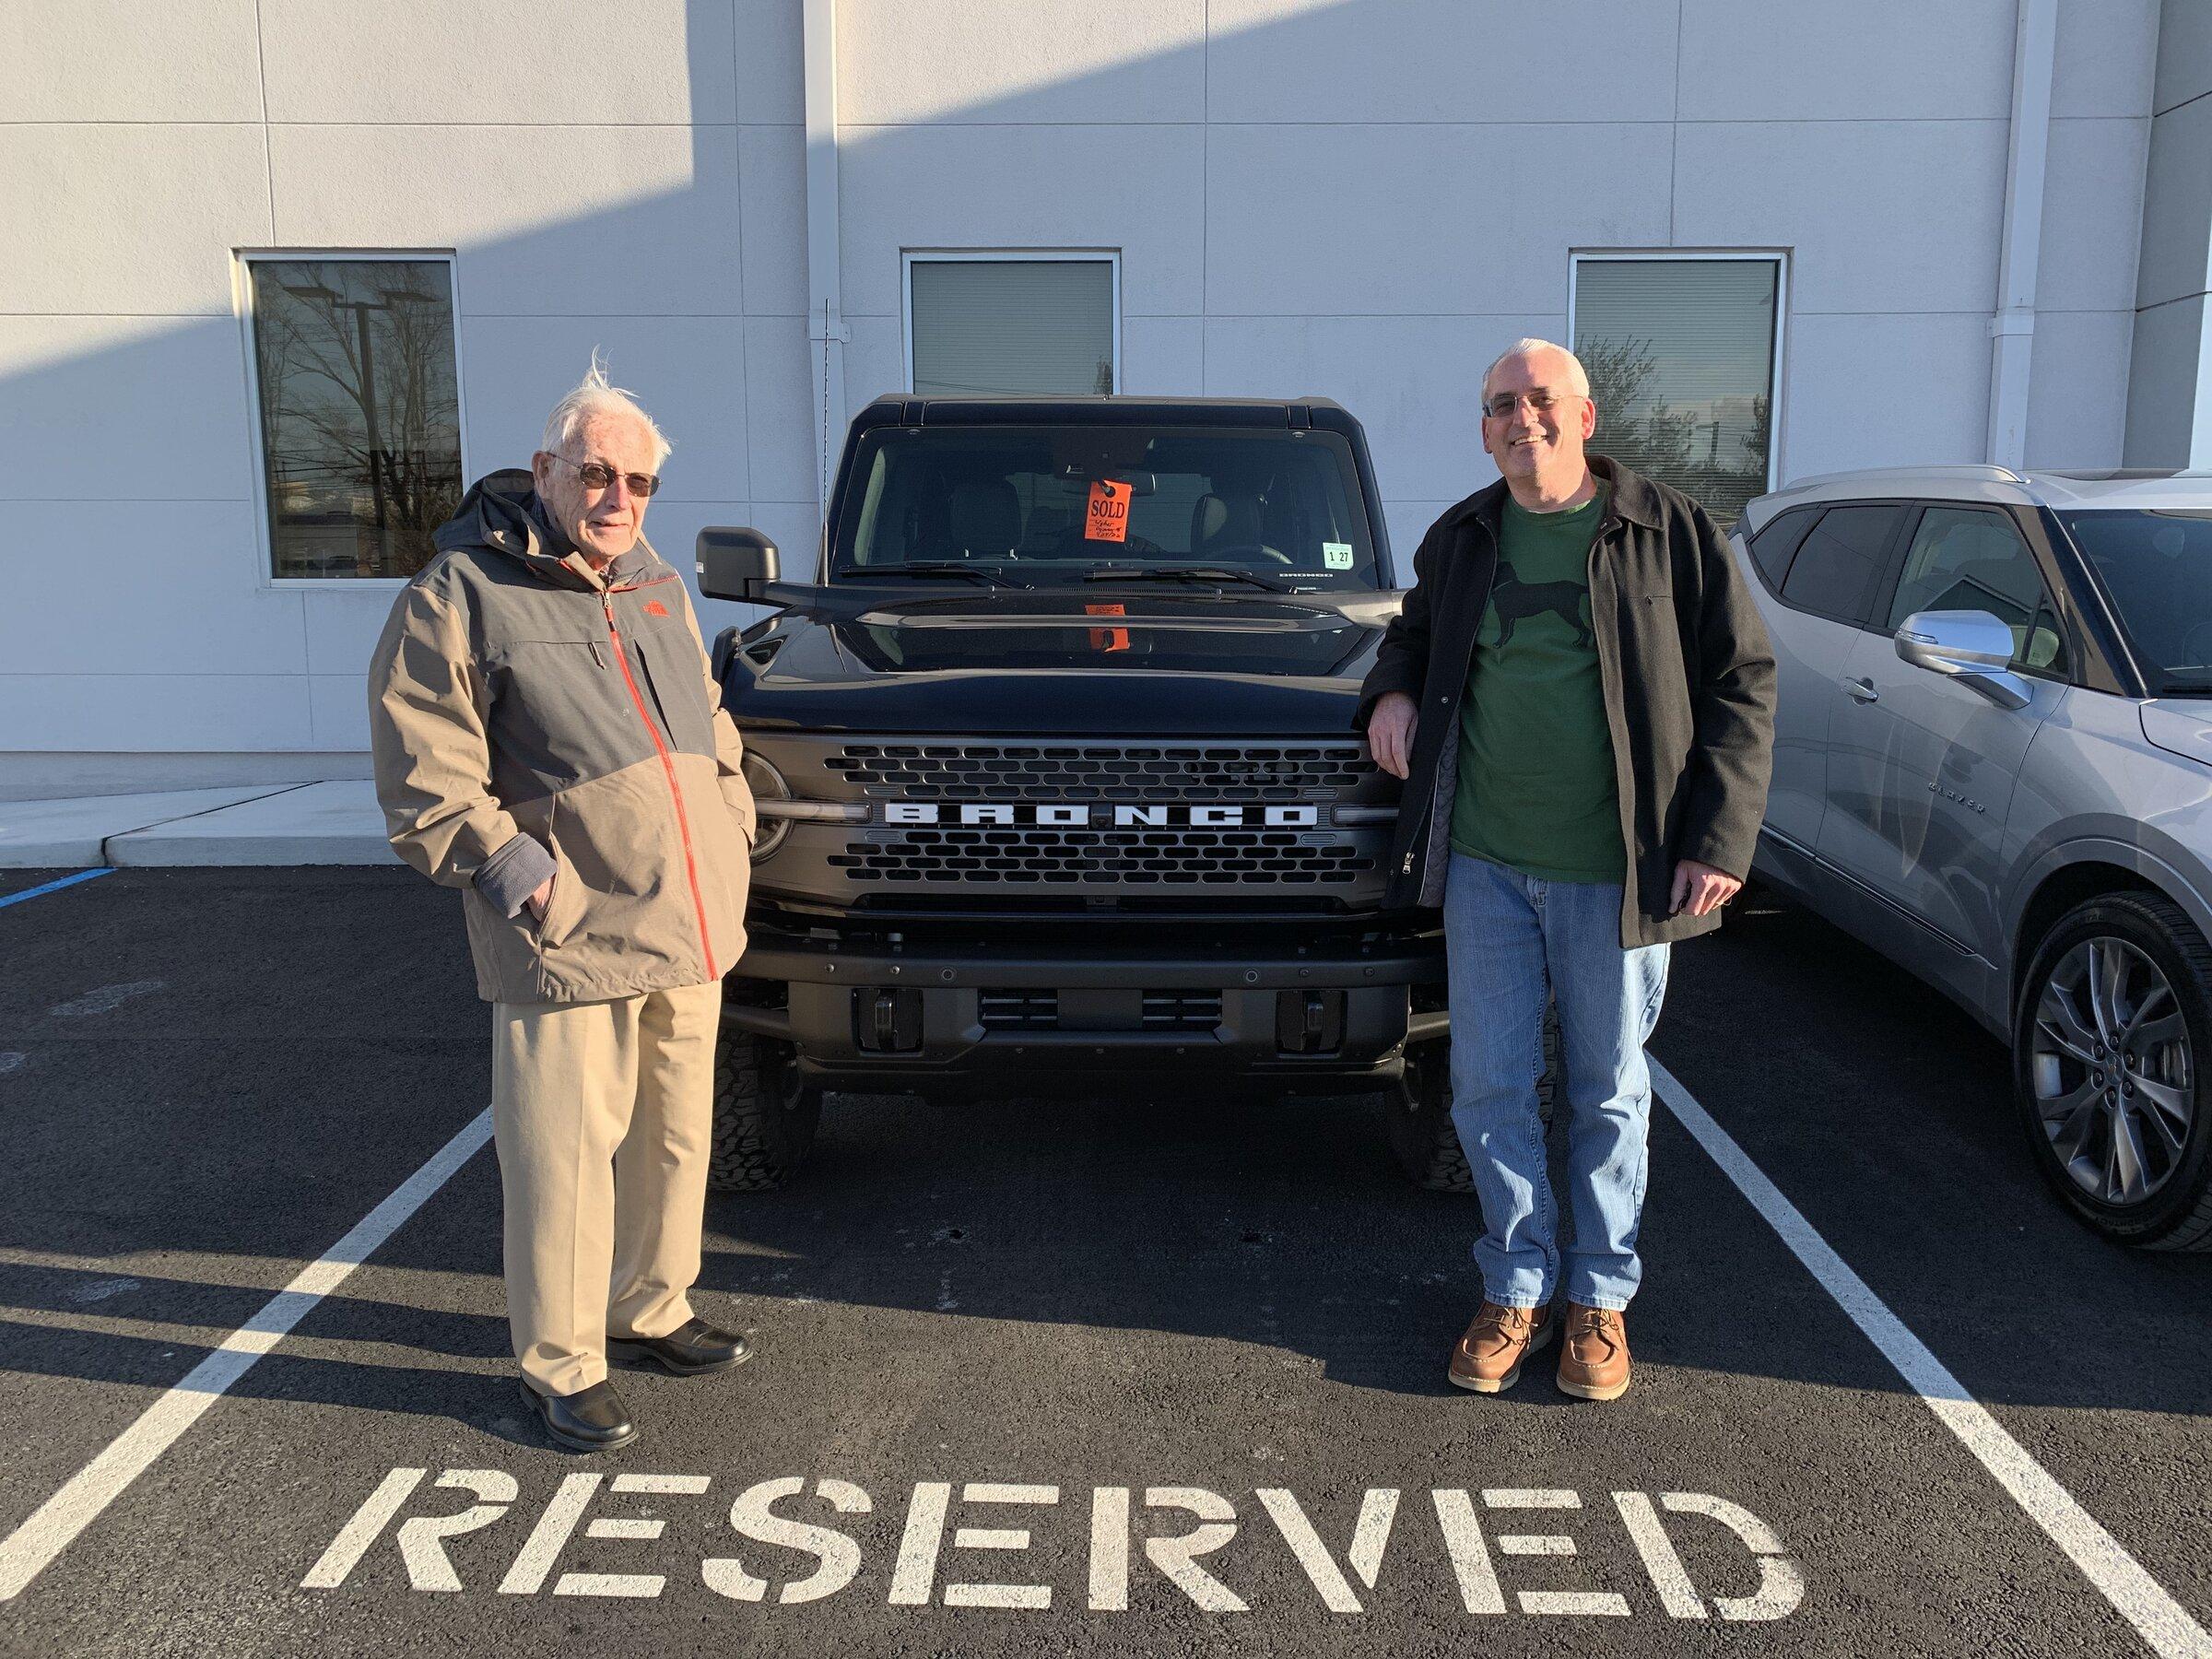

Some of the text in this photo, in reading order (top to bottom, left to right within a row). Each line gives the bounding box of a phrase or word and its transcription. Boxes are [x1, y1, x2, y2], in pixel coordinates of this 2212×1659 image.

[1091, 500, 1124, 518] SOLD
[1329, 551, 1348, 562] 1 27
[885, 803, 1319, 826] BRONCO
[300, 1467, 1805, 1620] RESERVED
